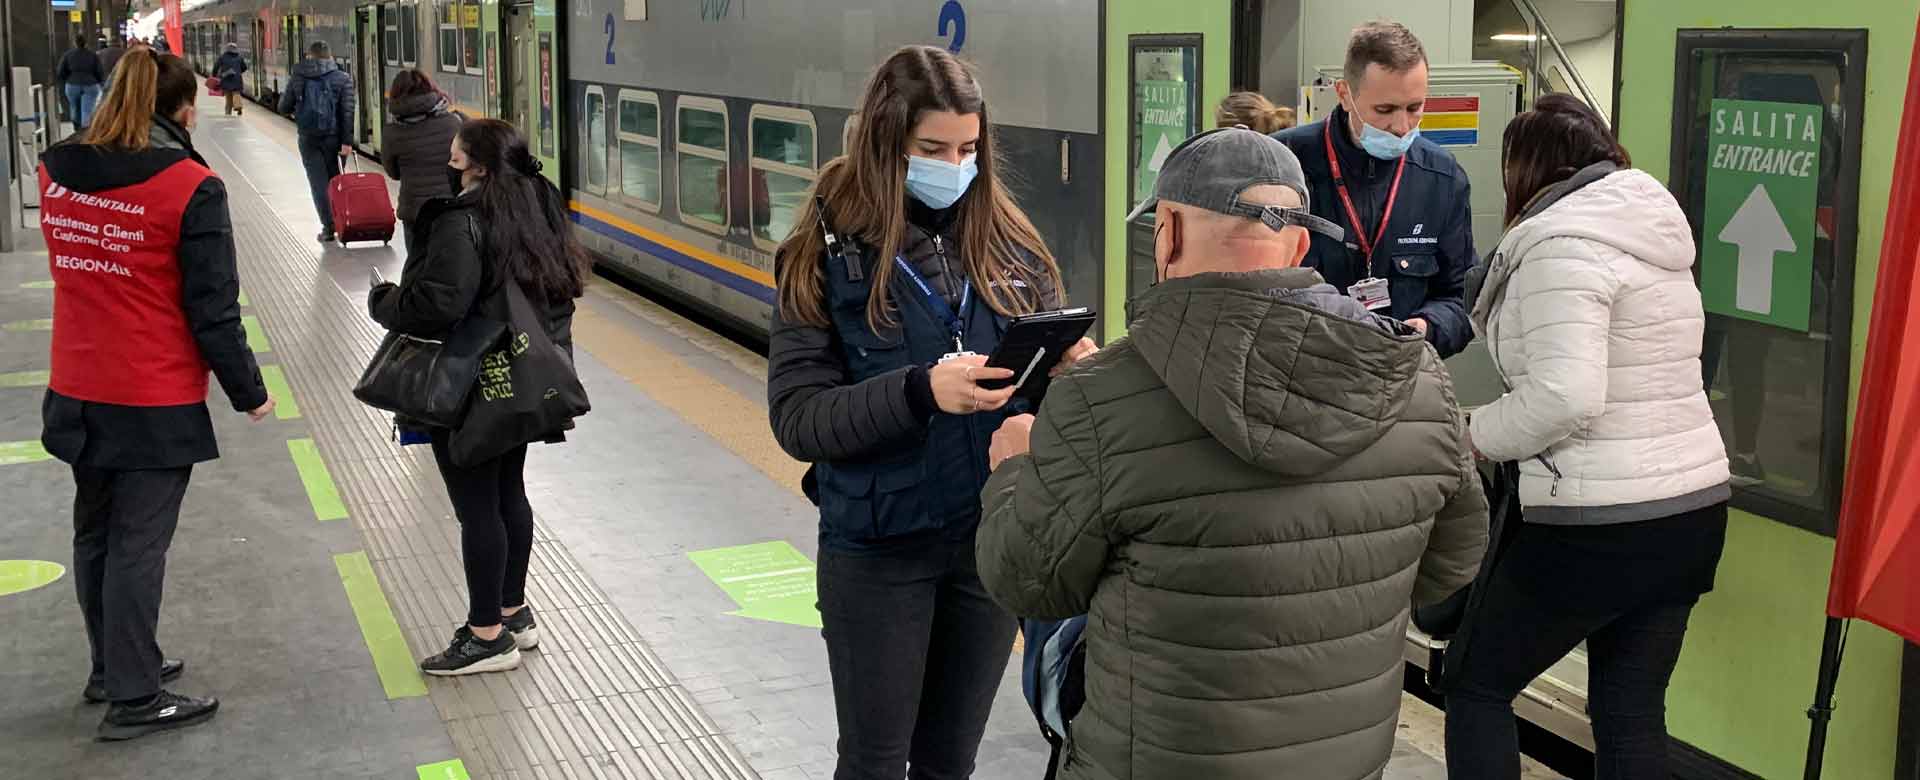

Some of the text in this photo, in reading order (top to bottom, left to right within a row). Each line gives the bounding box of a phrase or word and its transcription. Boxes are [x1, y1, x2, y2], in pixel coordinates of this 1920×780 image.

[603, 12, 616, 65] 2
[1143, 85, 1185, 105] SALITA
[1143, 109, 1186, 127] ENTRANCE
[1715, 109, 1816, 142] SALITA
[1712, 144, 1816, 177] ENTRANCE
[70, 192, 145, 215] TRENITALIA
[42, 211, 144, 242] Assistenza Clienti
[101, 238, 131, 253] Care
